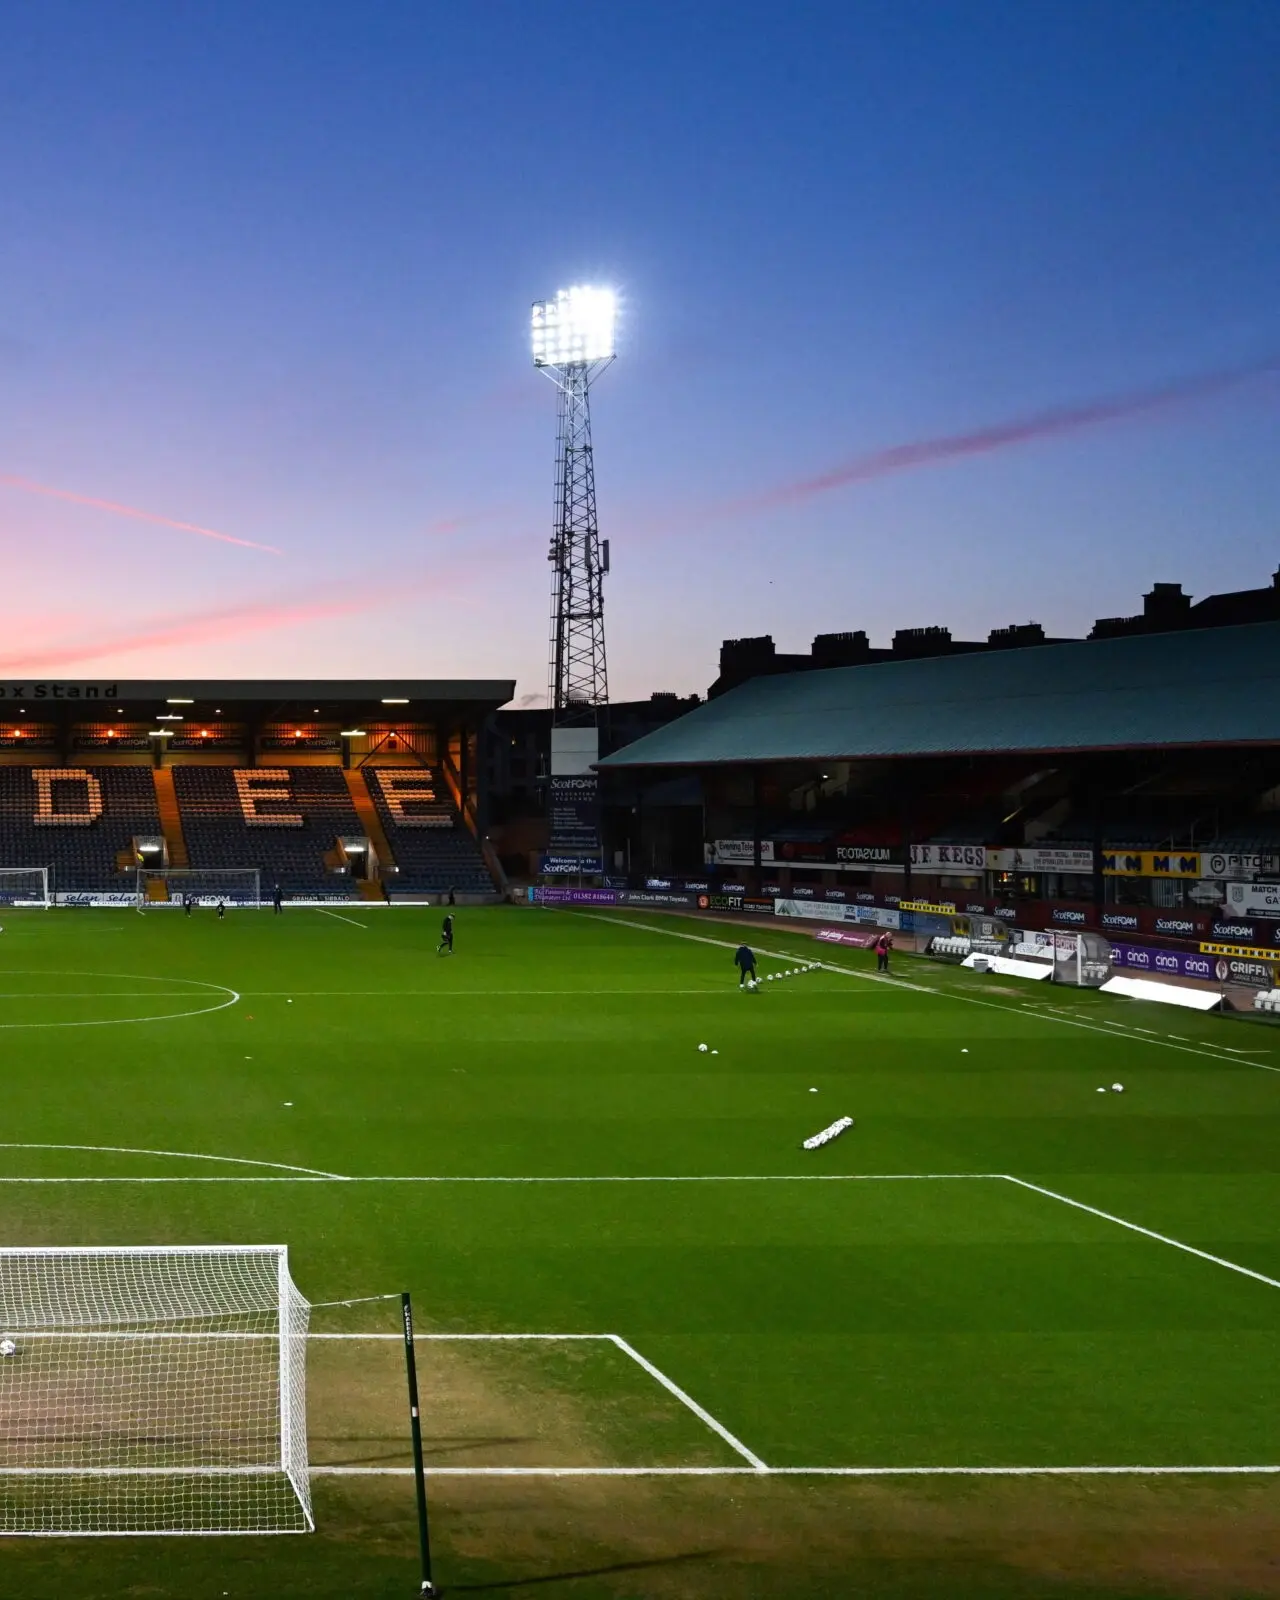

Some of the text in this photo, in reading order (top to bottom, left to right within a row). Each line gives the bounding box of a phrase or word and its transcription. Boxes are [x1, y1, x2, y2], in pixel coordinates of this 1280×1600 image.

[34, 684, 118, 699] Stand
[550, 778, 598, 789] ScotFOAM
[719, 841, 741, 853] Evening
[836, 847, 890, 861] FOOTASYLUM
[938, 847, 984, 867] KEGS
[1102, 854, 1142, 872] MKM
[1153, 855, 1197, 873] MKM
[1228, 856, 1274, 868] PITCH
[1251, 885, 1277, 893] MATCH
[64, 891, 98, 902] selan
[710, 895, 742, 907] ECOFIT
[1265, 896, 1280, 905] GA
[993, 906, 1016, 918] ScotFOAM
[1052, 909, 1085, 922] ScotFOAM
[1102, 913, 1138, 926] ScotFOAM
[1155, 918, 1194, 931] ScotFOAM
[1213, 922, 1254, 937] ScotFOAM
[1127, 949, 1149, 963] cinch
[1155, 952, 1178, 968] cinch
[1184, 957, 1209, 973] cinch
